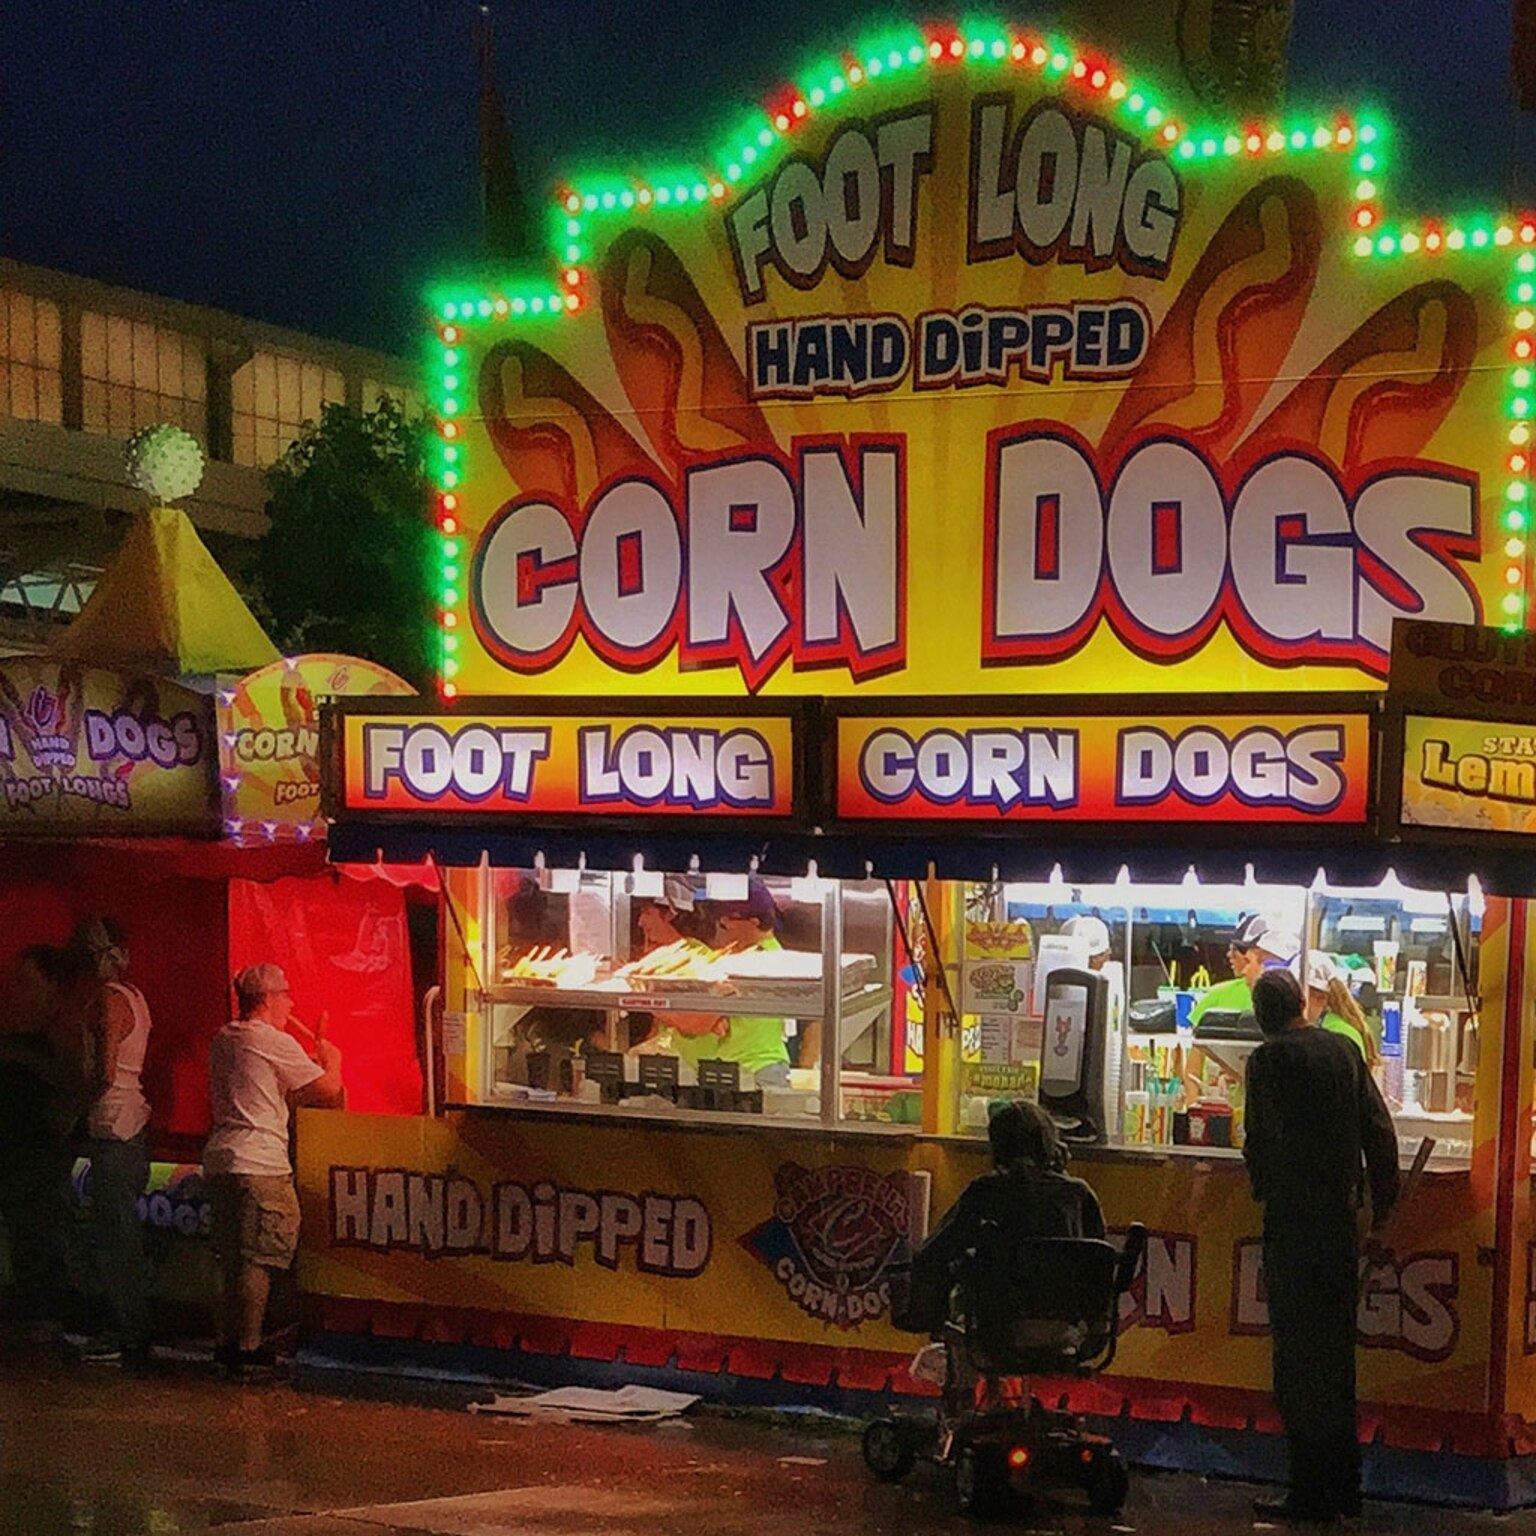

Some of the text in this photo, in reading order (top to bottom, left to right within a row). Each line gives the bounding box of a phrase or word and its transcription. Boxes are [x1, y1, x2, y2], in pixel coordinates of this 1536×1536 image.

[728, 100, 1182, 300] FOOT LONG
[752, 316, 907, 392] HAND
[477, 434, 1481, 676] CORN DOGS
[30, 735, 71, 751] HAND
[87, 710, 199, 767] DOGS
[236, 729, 319, 760] CORN
[367, 723, 775, 807] FOOT LONG
[861, 724, 1345, 812] CORN DOGS
[6, 778, 52, 803] FOOT
[275, 782, 319, 804] FOOT
[330, 1167, 486, 1252] HAND
[776, 1256, 839, 1318] CORN
